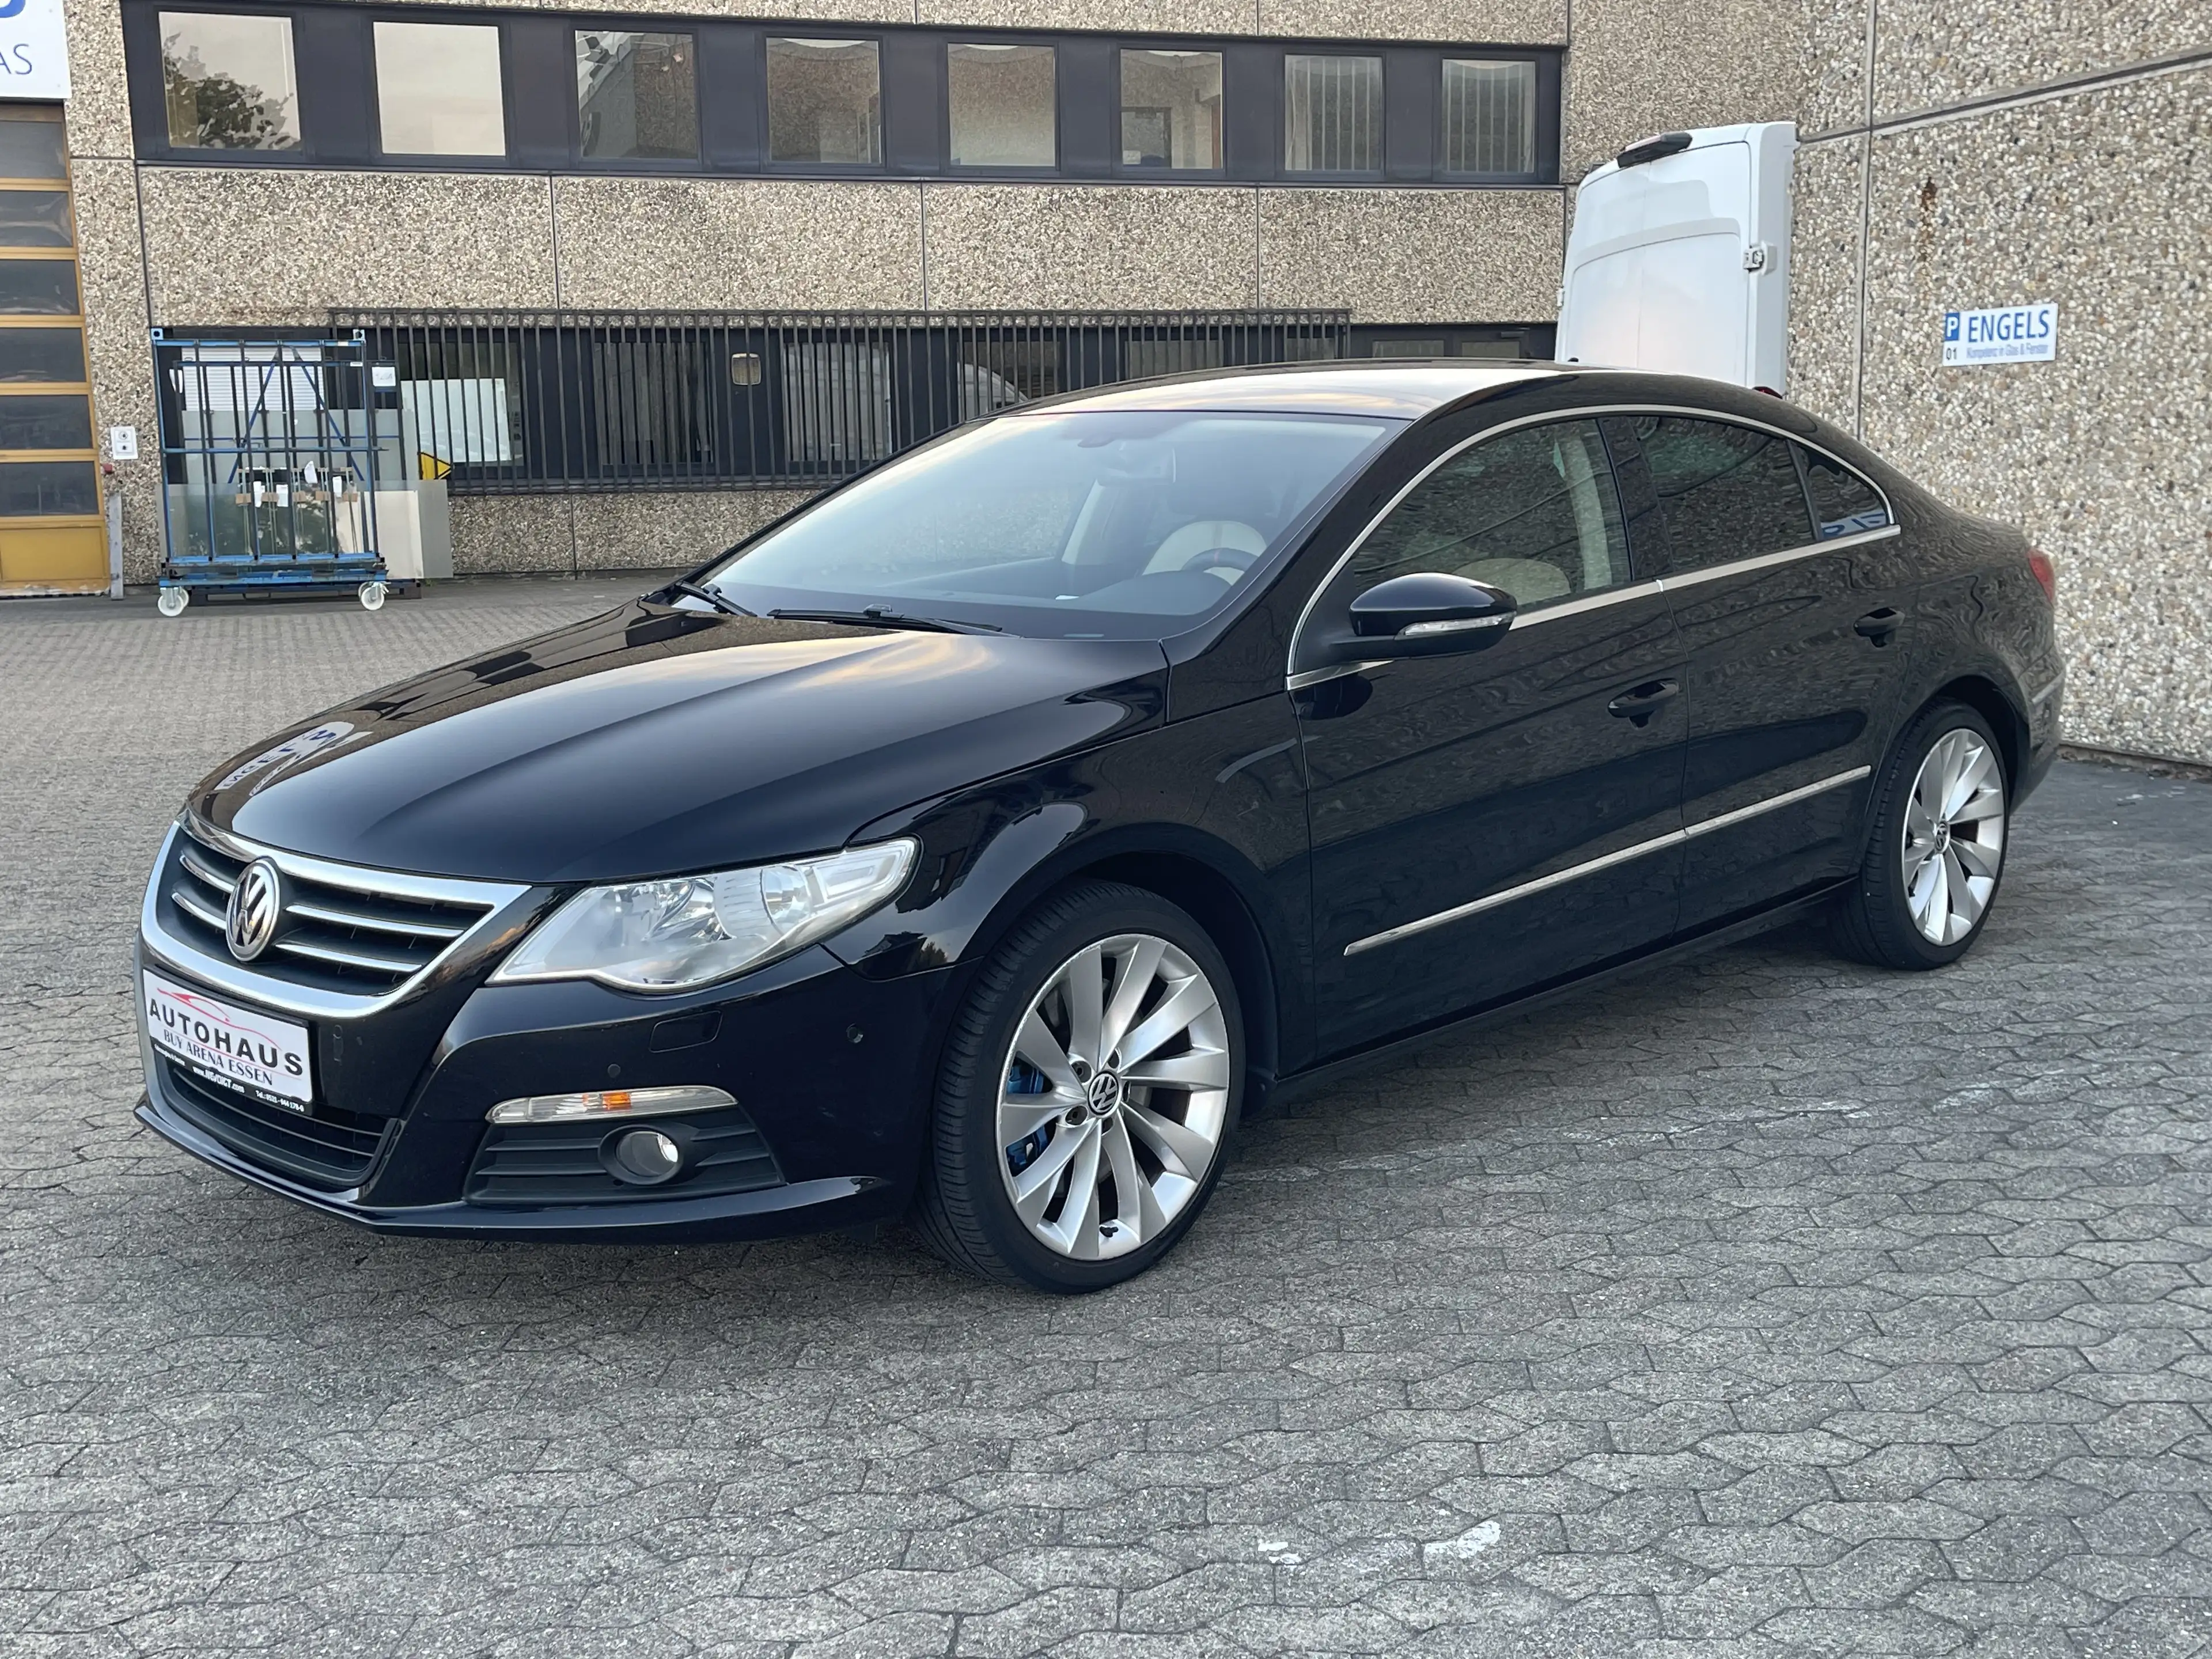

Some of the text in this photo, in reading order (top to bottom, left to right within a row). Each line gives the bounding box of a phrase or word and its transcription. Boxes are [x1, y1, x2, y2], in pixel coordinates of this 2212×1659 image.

[1968, 310, 2051, 343] ENGELS
[1945, 347, 1957, 361] 01
[149, 998, 303, 1076] AUTOHAUS
[164, 1029, 183, 1049] BUY
[186, 1041, 224, 1069] ARENA
[229, 1059, 272, 1086] ESSEN
